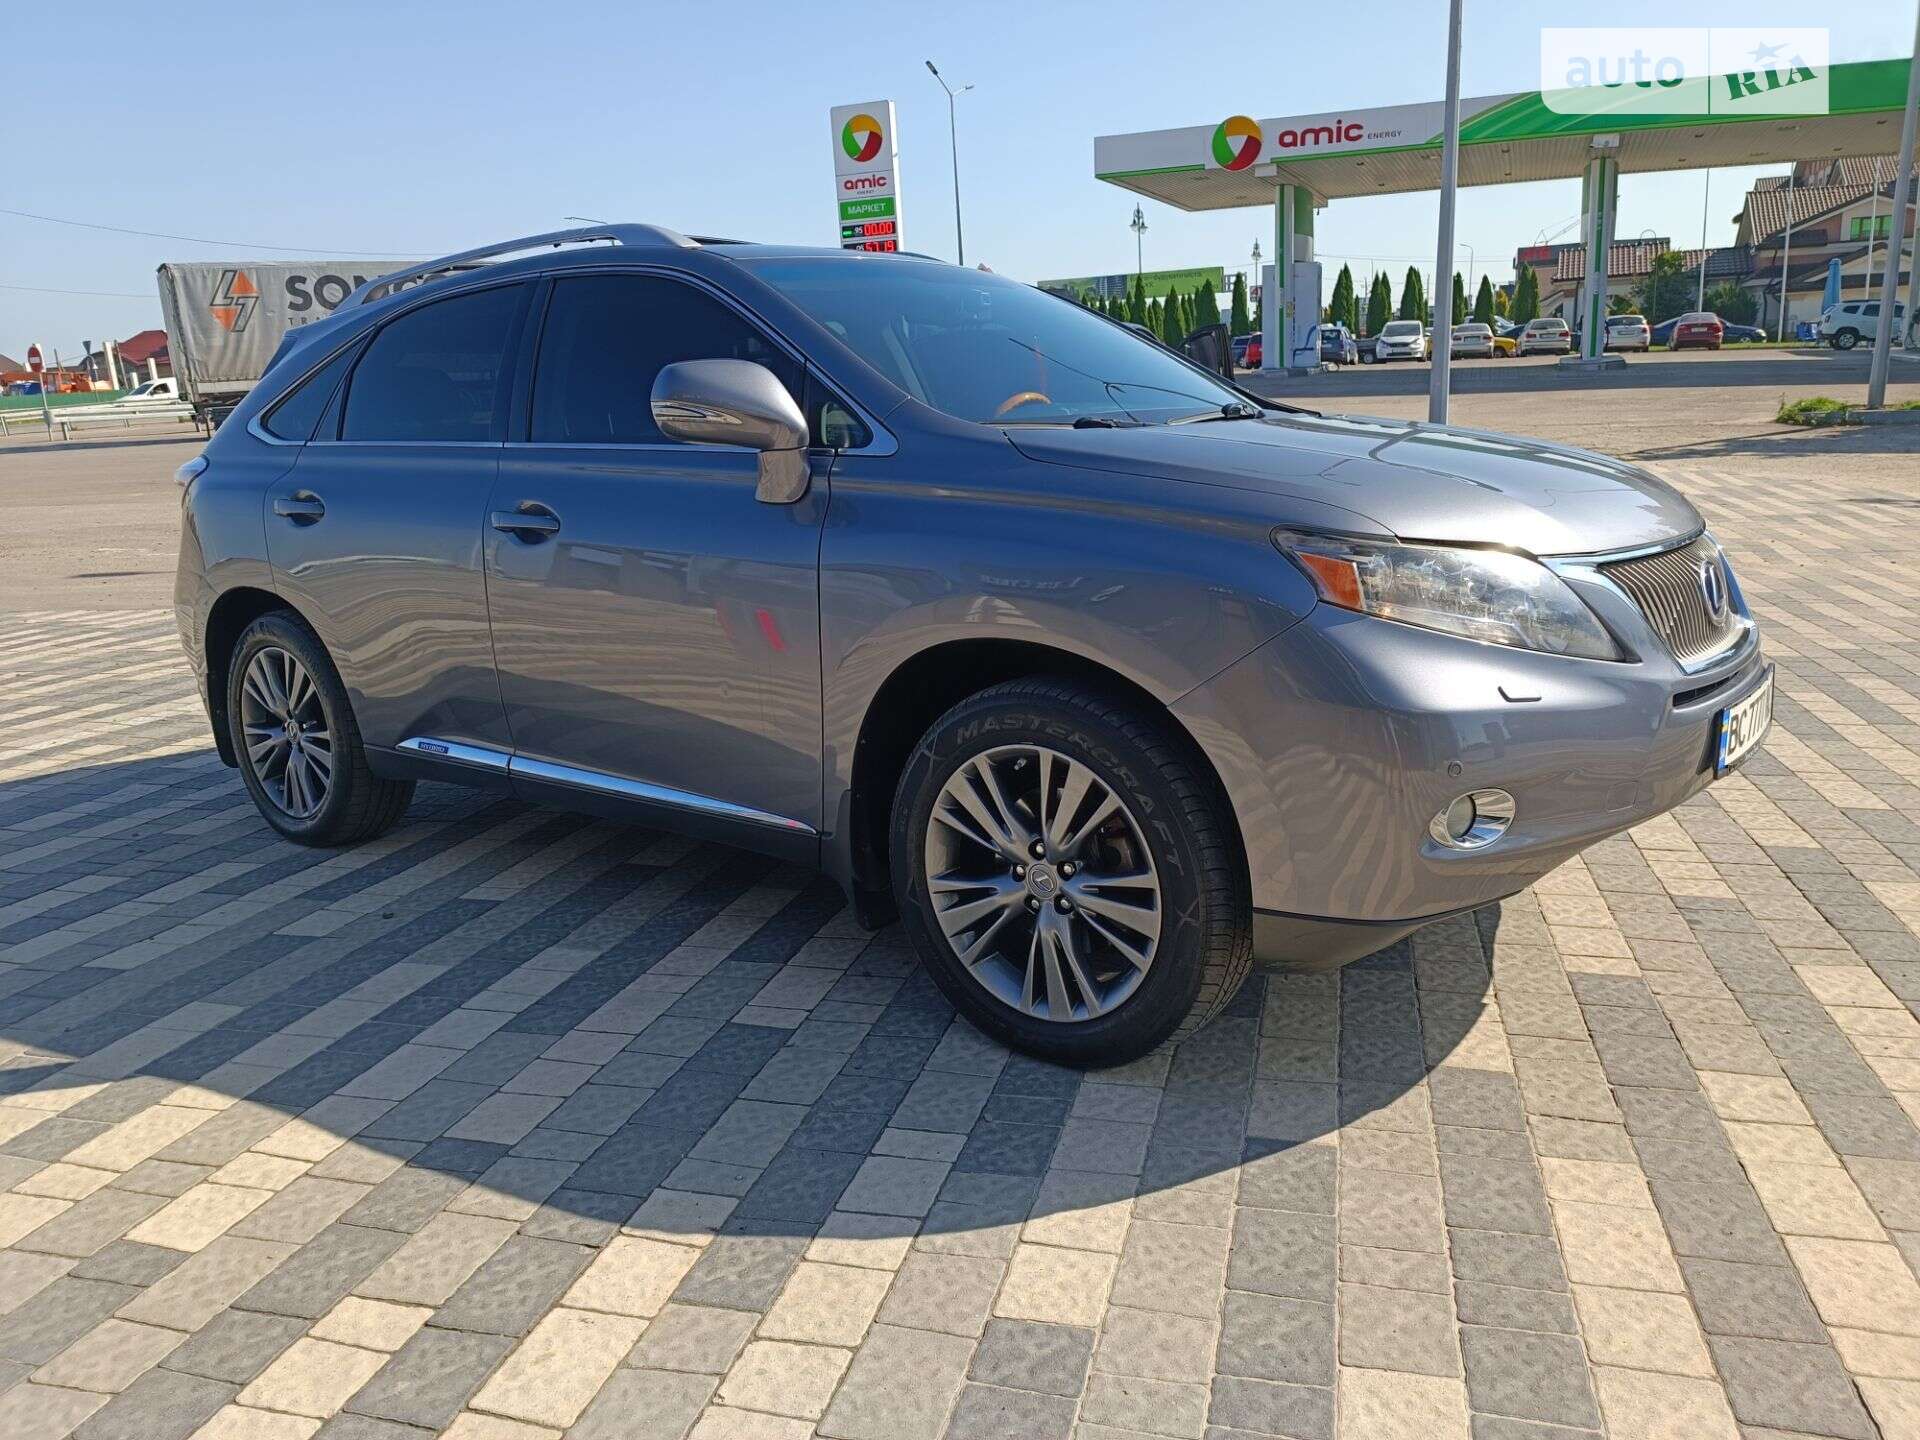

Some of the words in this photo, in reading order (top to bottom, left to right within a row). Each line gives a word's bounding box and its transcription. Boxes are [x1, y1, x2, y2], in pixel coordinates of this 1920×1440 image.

[1278, 119, 1365, 148] amic
[1367, 130, 1402, 140] ENERGY
[844, 174, 887, 190] amic
[956, 714, 1185, 877] MASTERCRAFT
